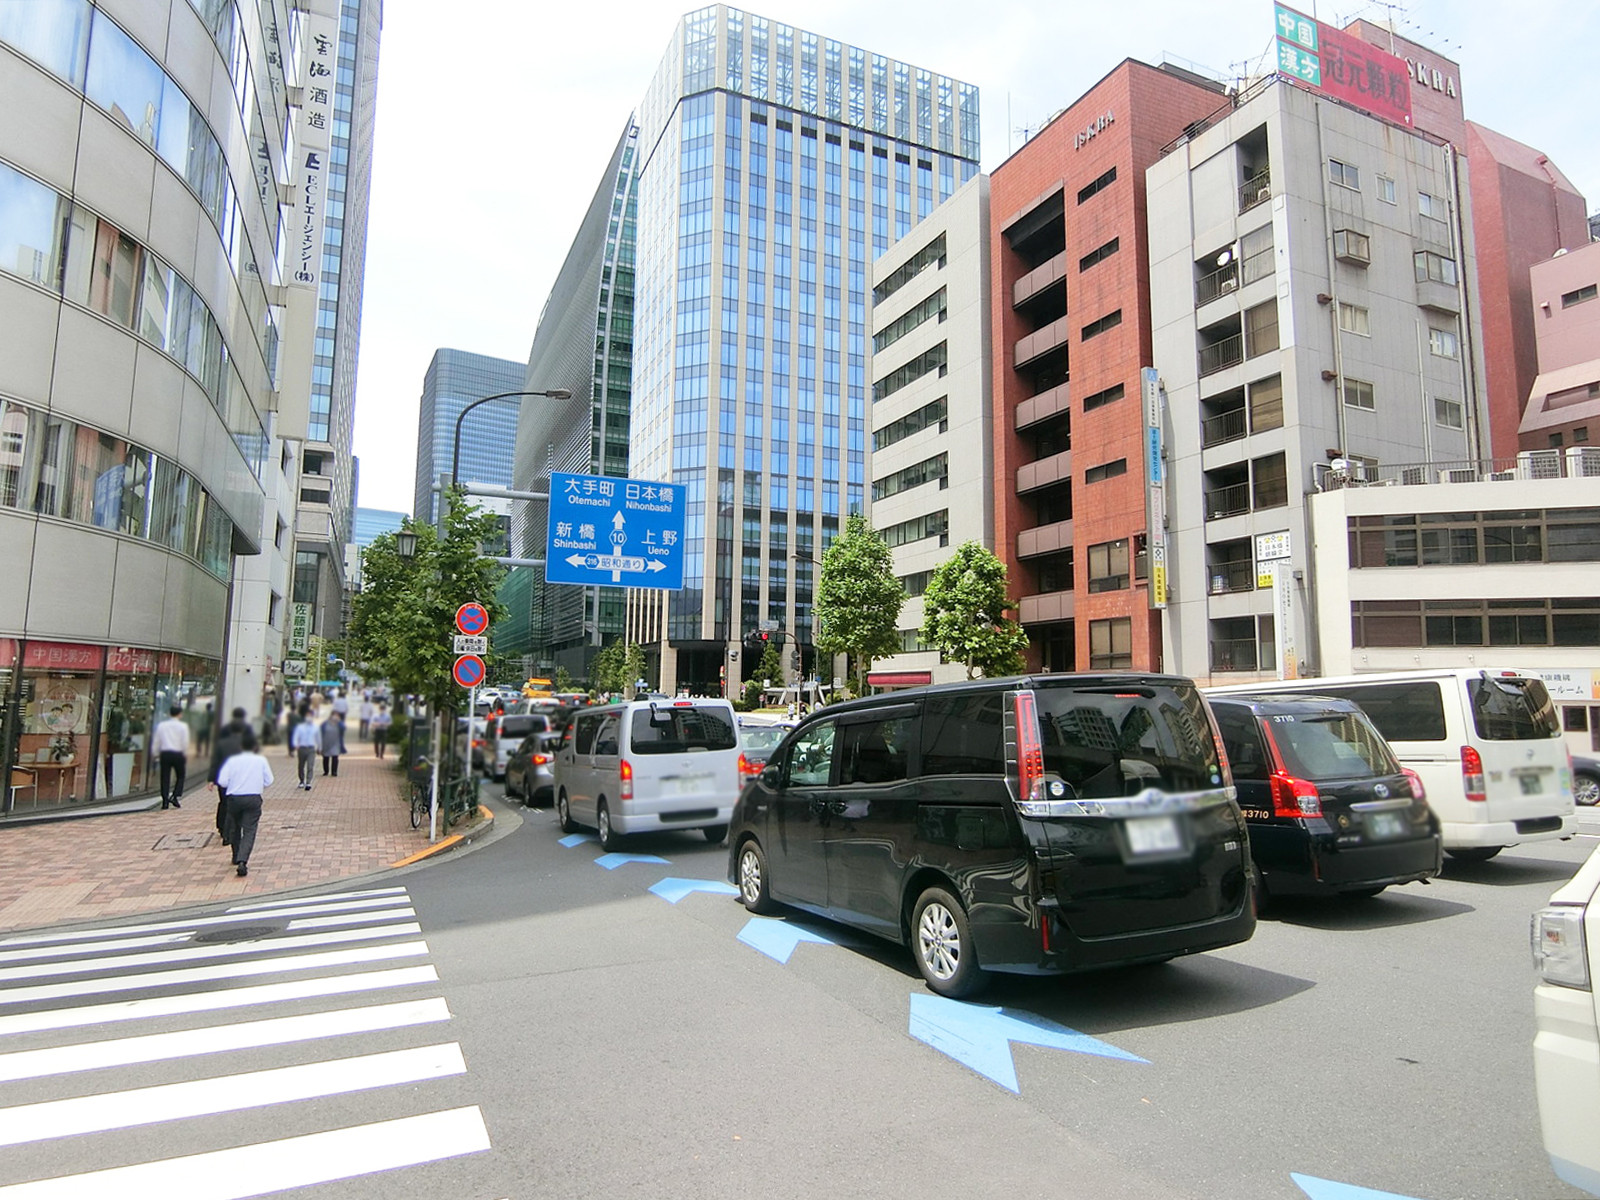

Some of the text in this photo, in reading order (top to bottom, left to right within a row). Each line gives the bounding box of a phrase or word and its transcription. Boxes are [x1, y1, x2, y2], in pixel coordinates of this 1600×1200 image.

[1277, 12, 1314, 49] 中国
[1279, 45, 1319, 79] 漢方
[308, 33, 333, 130] 雲海酒造
[1393, 51, 1457, 98] SKRA
[1074, 110, 1115, 150] ISKRA
[564, 478, 674, 503] 大手町 日本橋
[568, 494, 672, 513] Otemachi Nihonbashi
[556, 521, 595, 540] 新橋
[612, 532, 624, 543] 10
[641, 529, 678, 546] 上野
[553, 538, 597, 550] Shinbashi
[648, 546, 670, 556] Ueno
[601, 557, 641, 569] 昭和通り
[292, 603, 308, 649] 佐藤歯科
[33, 647, 92, 664] 中国漢方
[285, 661, 304, 677] うどん
[1273, 714, 1295, 723] 3710
